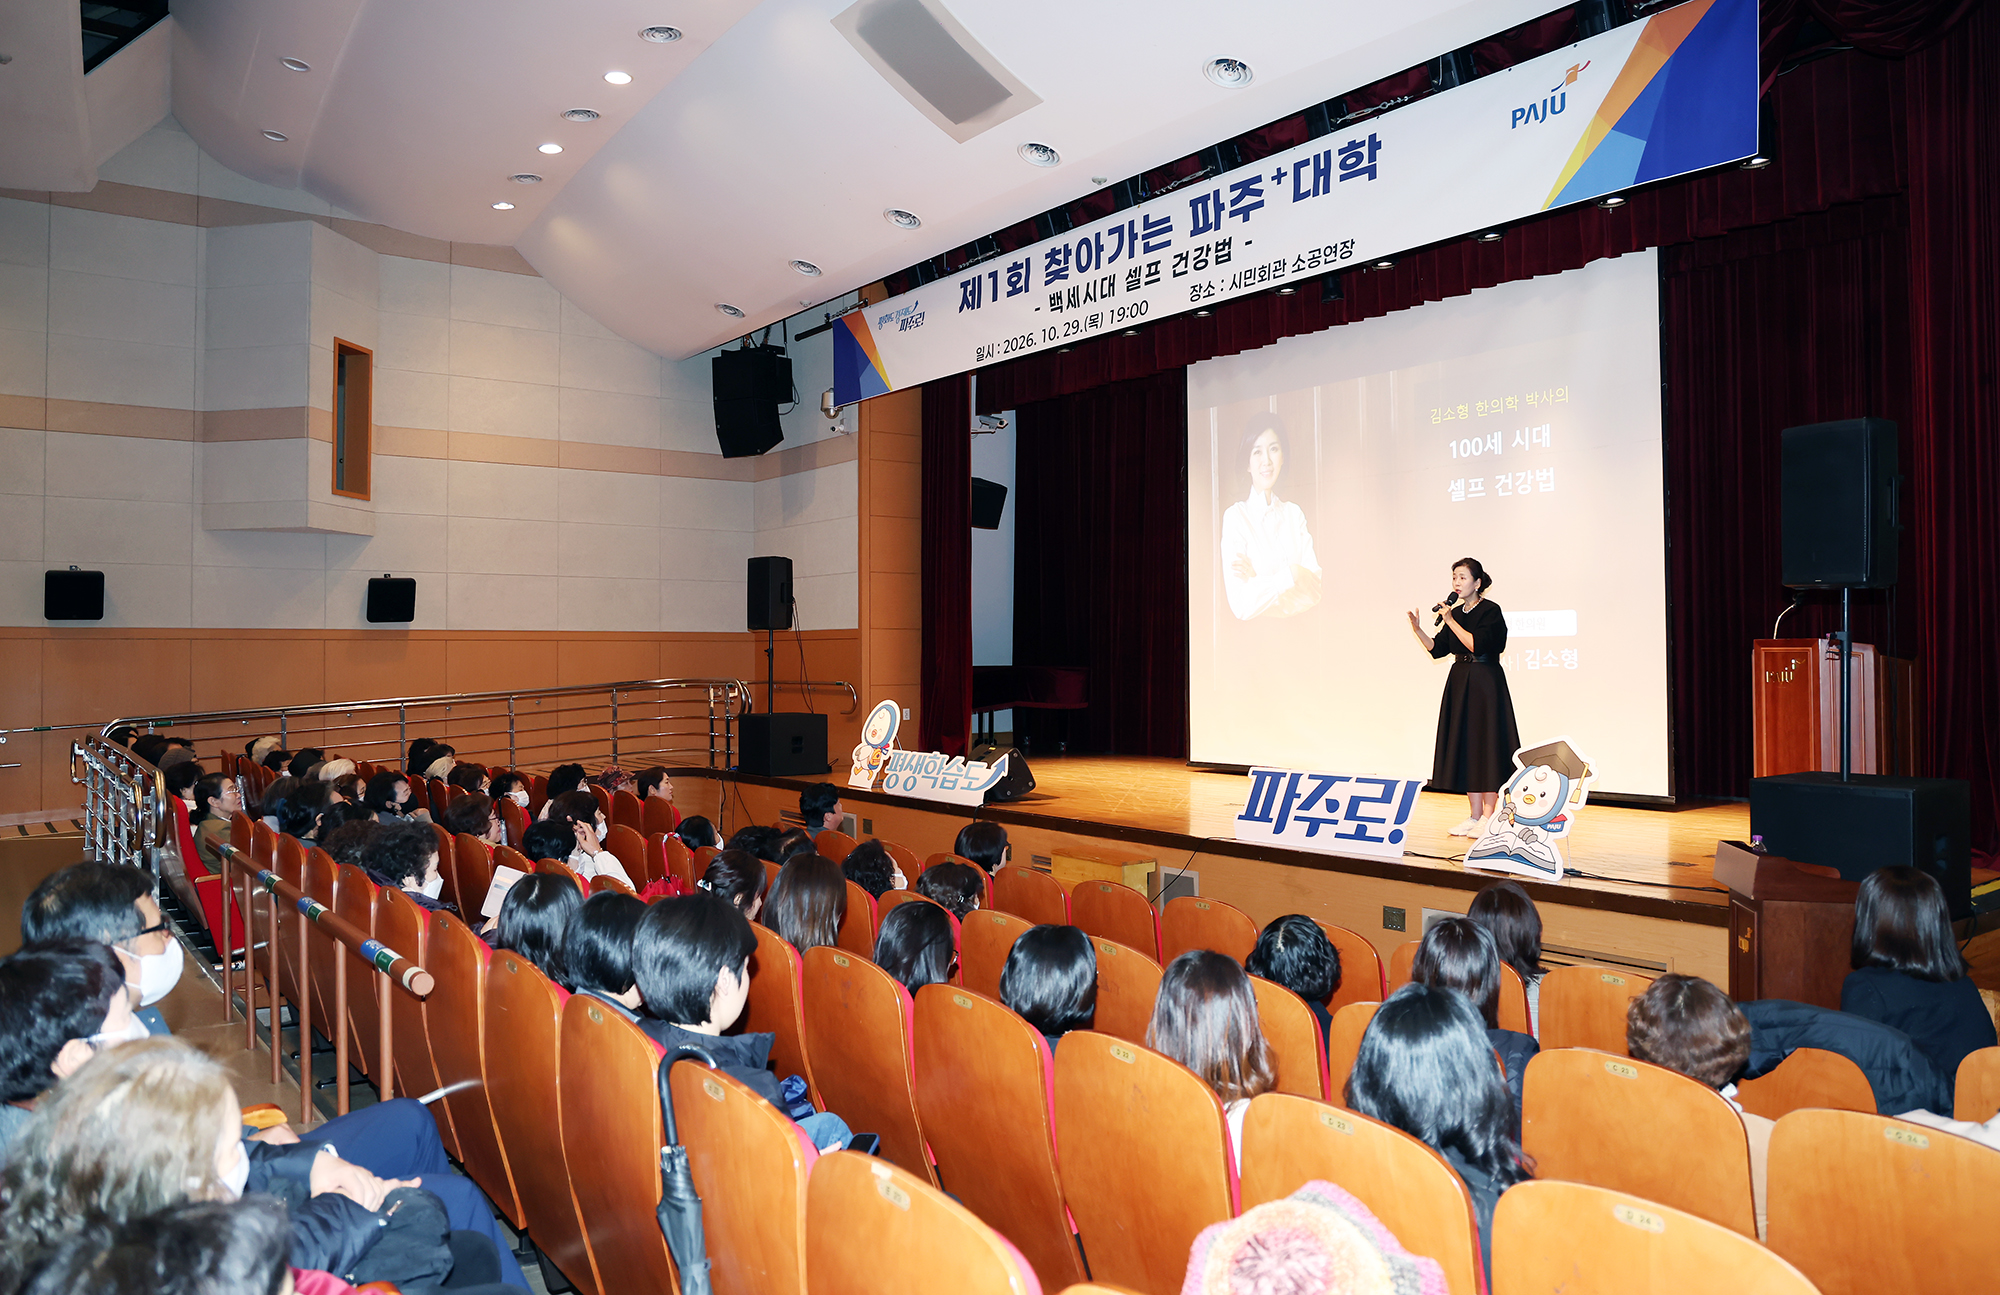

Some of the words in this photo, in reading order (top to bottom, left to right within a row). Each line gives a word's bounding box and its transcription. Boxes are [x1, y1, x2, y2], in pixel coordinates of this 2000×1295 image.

[1511, 90, 1567, 129] PAJU
[959, 257, 1031, 313] 제1회
[1044, 213, 1174, 286] 찾아가는
[1049, 273, 1116, 313] 백세시대
[1125, 260, 1161, 292] 셀프
[1172, 236, 1232, 278] 건강법
[1189, 281, 1215, 302] 장소
[1229, 258, 1287, 291] 시민회관
[1291, 238, 1355, 274] 소공연장
[899, 311, 925, 332] 파주로!
[975, 342, 994, 362] 일시
[1003, 334, 1037, 354] 2026.
[1041, 326, 1059, 343] 10.
[1109, 300, 1149, 324] 19:00
[1430, 402, 1469, 424] 김소형
[1475, 394, 1519, 417] 한의학
[1525, 385, 1569, 408] 박사의
[1449, 430, 1503, 459] 100세
[1511, 423, 1551, 451] 시대
[1447, 478, 1487, 502] 셀프
[1494, 467, 1555, 497] 건강법
[1525, 648, 1578, 670] 김소형
[886, 752, 985, 791] 평생학습도
[1237, 770, 1422, 844] 파주로!
